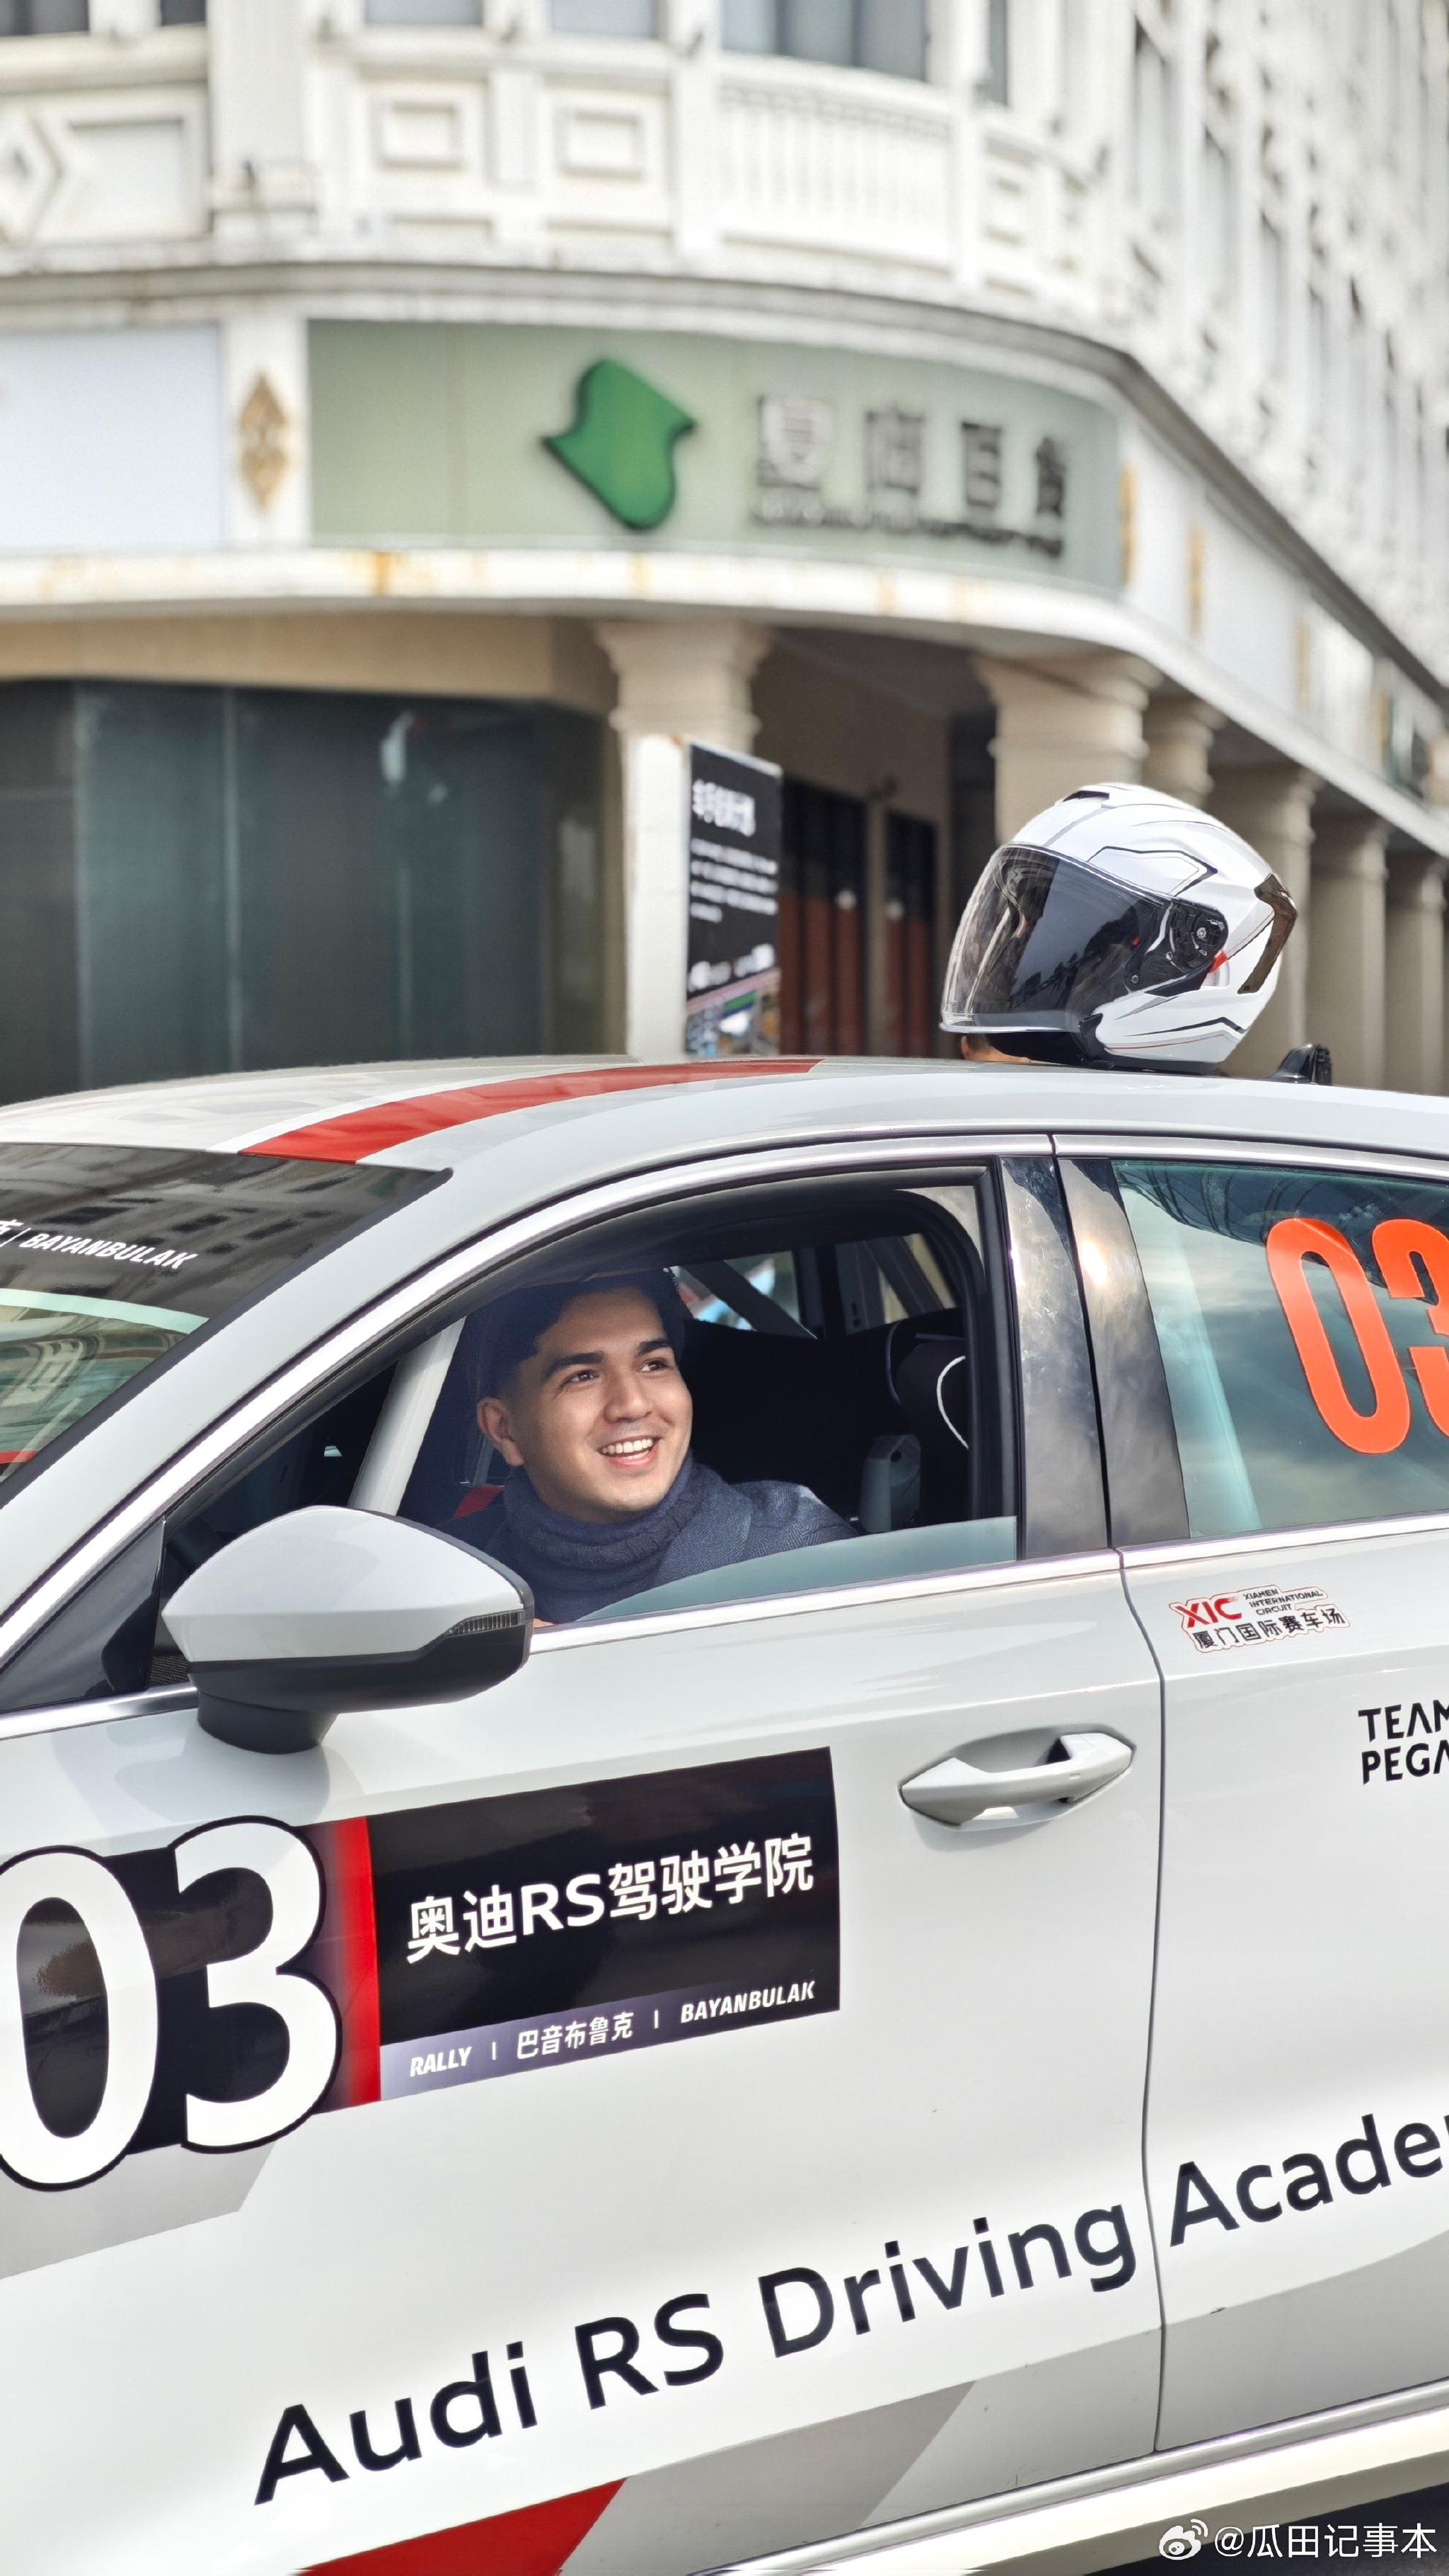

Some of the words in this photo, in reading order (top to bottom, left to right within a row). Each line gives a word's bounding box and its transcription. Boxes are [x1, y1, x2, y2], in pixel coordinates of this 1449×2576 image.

[18, 1233, 198, 1269] BAYANBULAK
[1176, 1597, 1242, 1628] XIC
[1243, 1589, 1279, 1600] XIAMEN
[1249, 1590, 1324, 1608] INTERNATIONAL
[1255, 1603, 1292, 1616] CIRCUIT
[1192, 1608, 1345, 1649] 厦门国际赛车场
[1358, 1699, 1449, 1743] TEAM
[406, 1833, 814, 1964] 奥迪RS驾驶学院
[0, 1816, 342, 2192] 03
[410, 2046, 472, 2077] RALLY
[516, 2010, 634, 2059] 巴音布鲁克
[681, 1981, 815, 2024] BAYANBULAK
[254, 2340, 538, 2506] Audi
[575, 2293, 724, 2410] RS
[758, 2204, 1136, 2358] Driving
[1170, 2113, 1449, 2248] Acade
